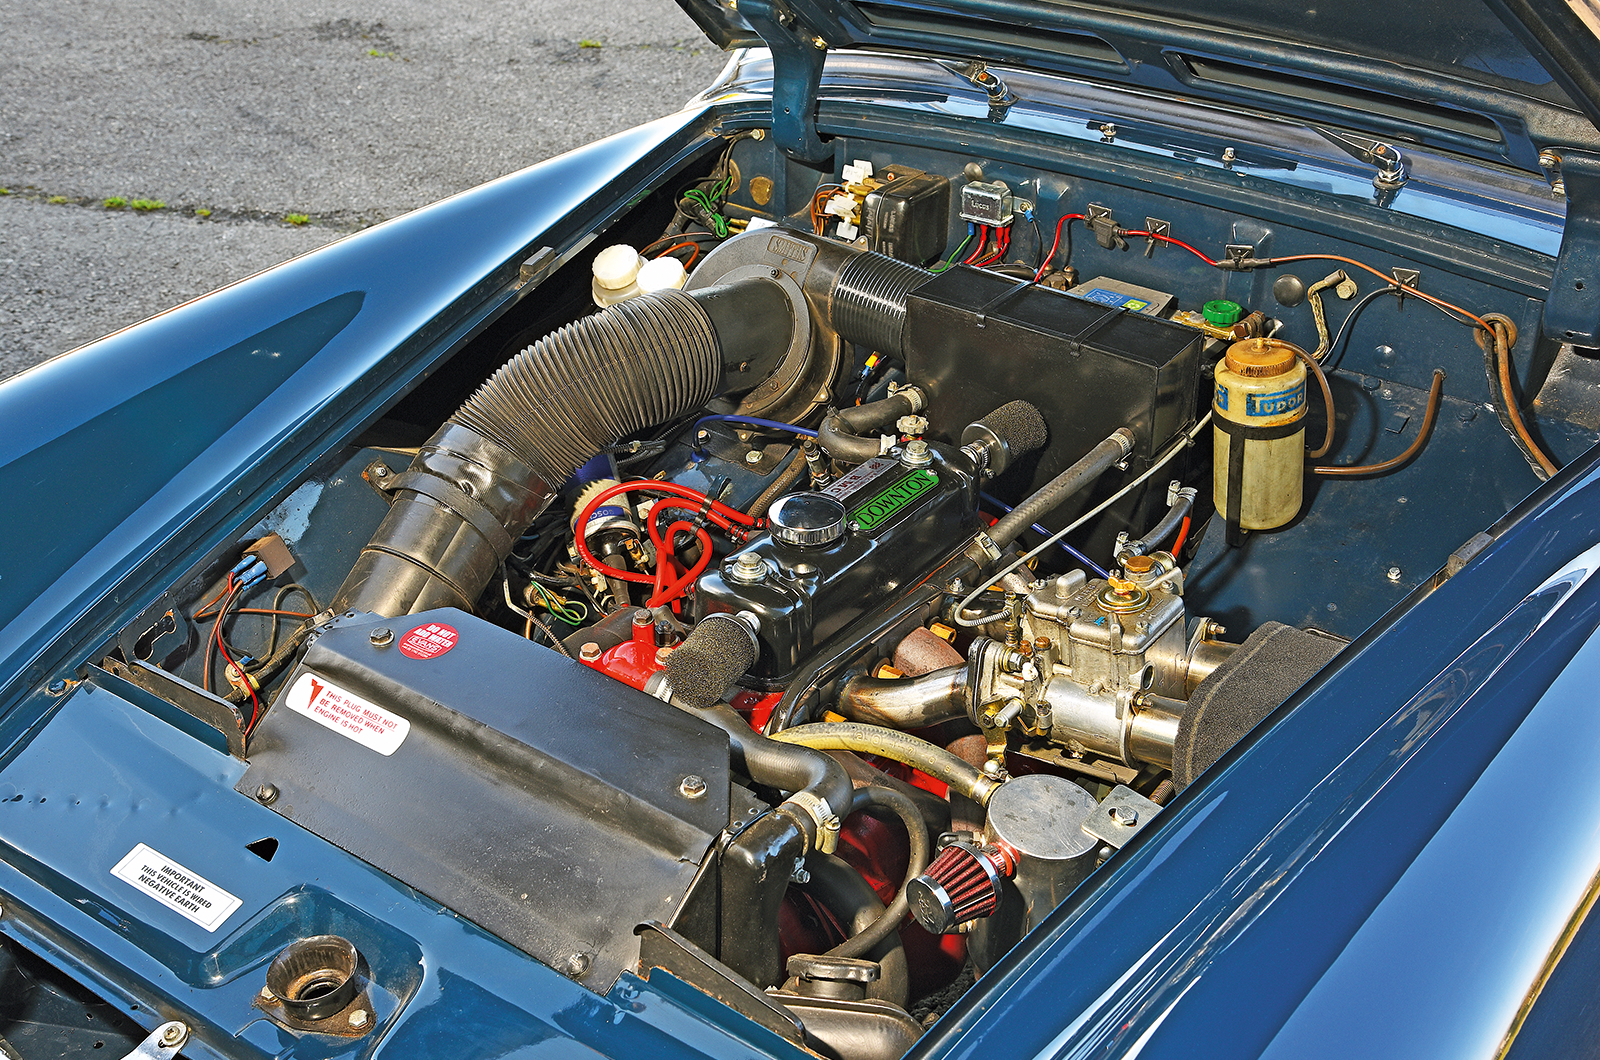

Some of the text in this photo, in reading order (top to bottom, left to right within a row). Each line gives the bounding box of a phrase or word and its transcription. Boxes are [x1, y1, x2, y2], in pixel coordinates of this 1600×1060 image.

[1251, 386, 1304, 413] TUDOR
[857, 472, 932, 526] DOWNTON
[413, 628, 453, 648] ADD WATER
[426, 624, 456, 639] DO NOT
[314, 706, 341, 723] ENGINE
[348, 725, 363, 734] HOT
[319, 698, 385, 734] BE REMOVED WHEN
[326, 690, 398, 729] THIS PLUG MUST NOT
[138, 874, 200, 913] NEGATIVE EARTH
[141, 865, 212, 909] THIS VEHICLE IS WIRED
[161, 865, 205, 893] IMPORTANT
